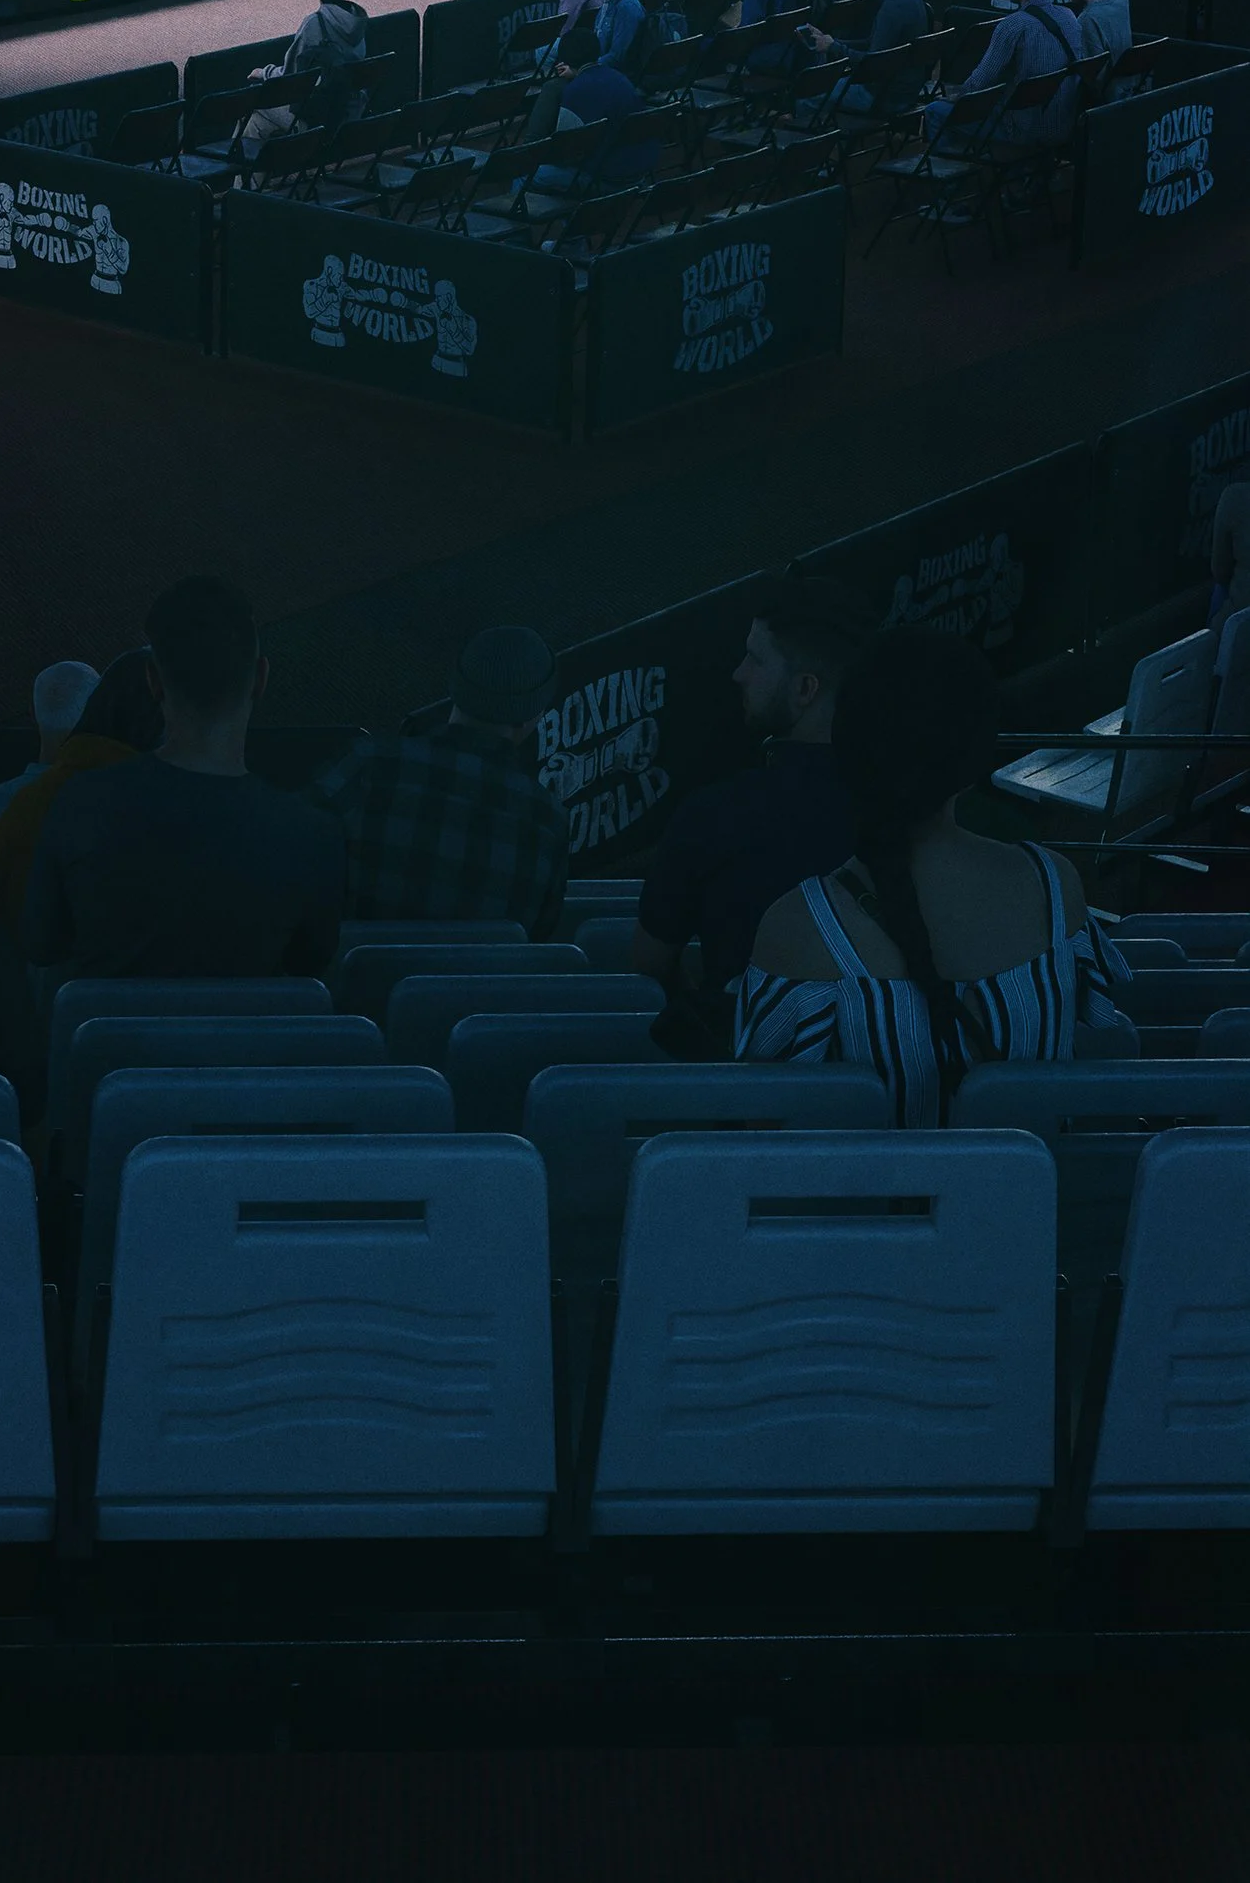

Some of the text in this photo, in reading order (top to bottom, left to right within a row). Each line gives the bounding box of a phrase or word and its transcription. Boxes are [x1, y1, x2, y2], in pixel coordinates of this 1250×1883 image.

[1147, 104, 1214, 154] BOXING
[17, 179, 88, 219] BOXING
[1138, 169, 1215, 216] WORLD
[14, 225, 93, 264] WORLD
[348, 252, 431, 295] BOXING
[681, 243, 772, 302] BOXING
[344, 299, 435, 344] WORLD
[673, 316, 775, 373] WORLD
[537, 665, 667, 762] BOXING
[568, 766, 671, 855] ORLD
